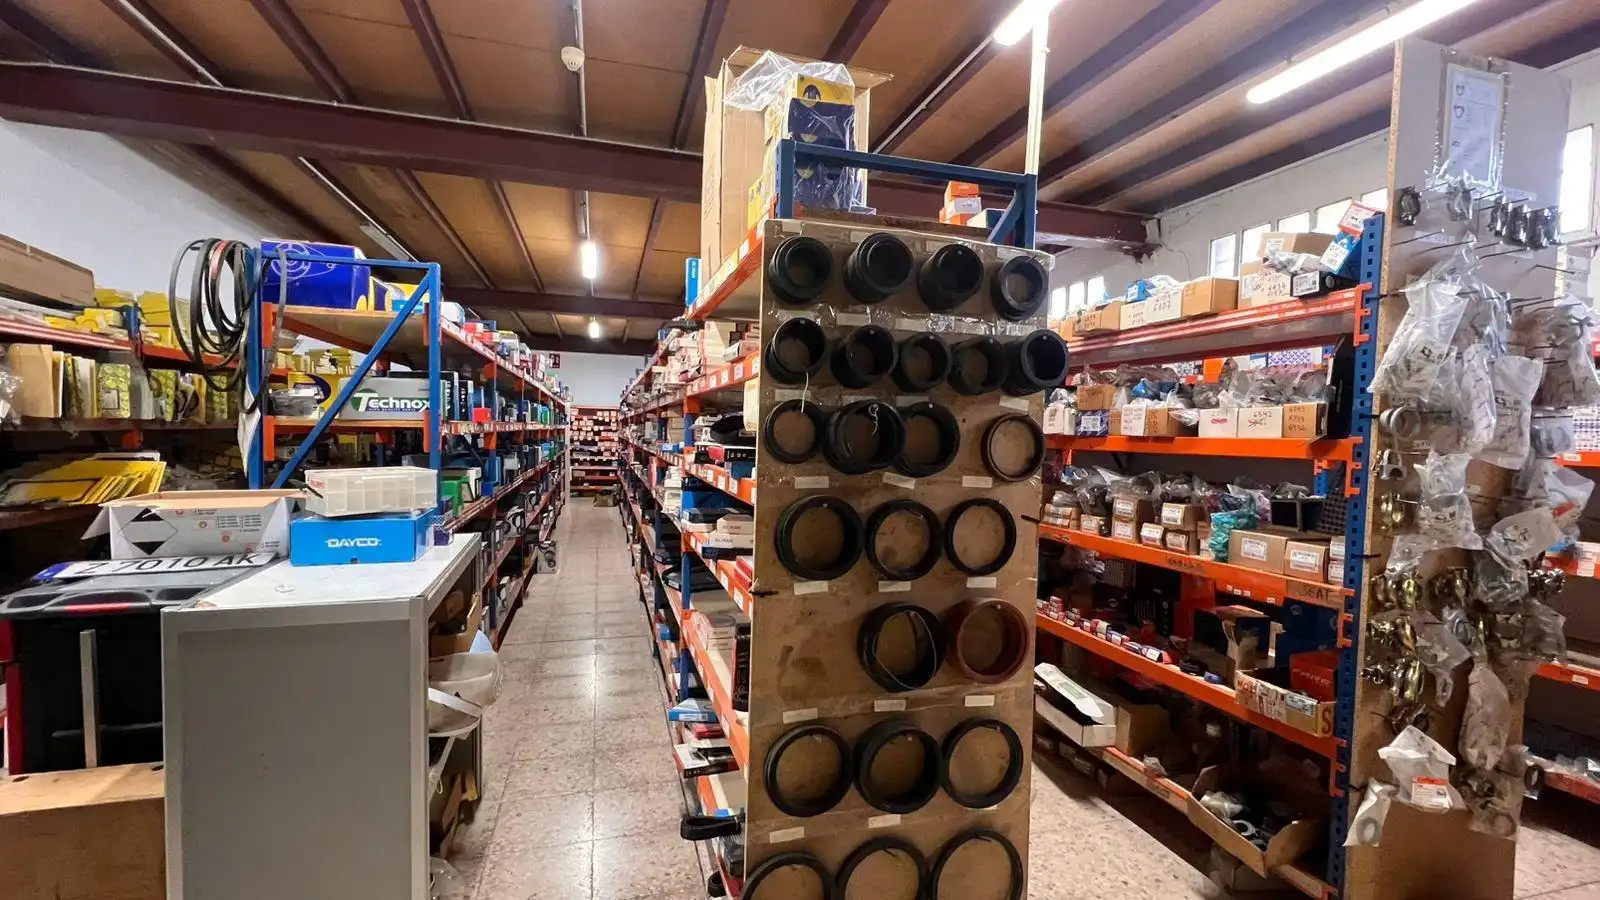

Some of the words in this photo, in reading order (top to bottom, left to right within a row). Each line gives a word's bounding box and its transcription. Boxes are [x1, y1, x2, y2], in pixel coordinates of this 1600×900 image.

[326, 537, 380, 548] DAYCO
[76, 562, 103, 575] Z
[112, 557, 207, 573] 7010
[214, 553, 257, 567] AK
